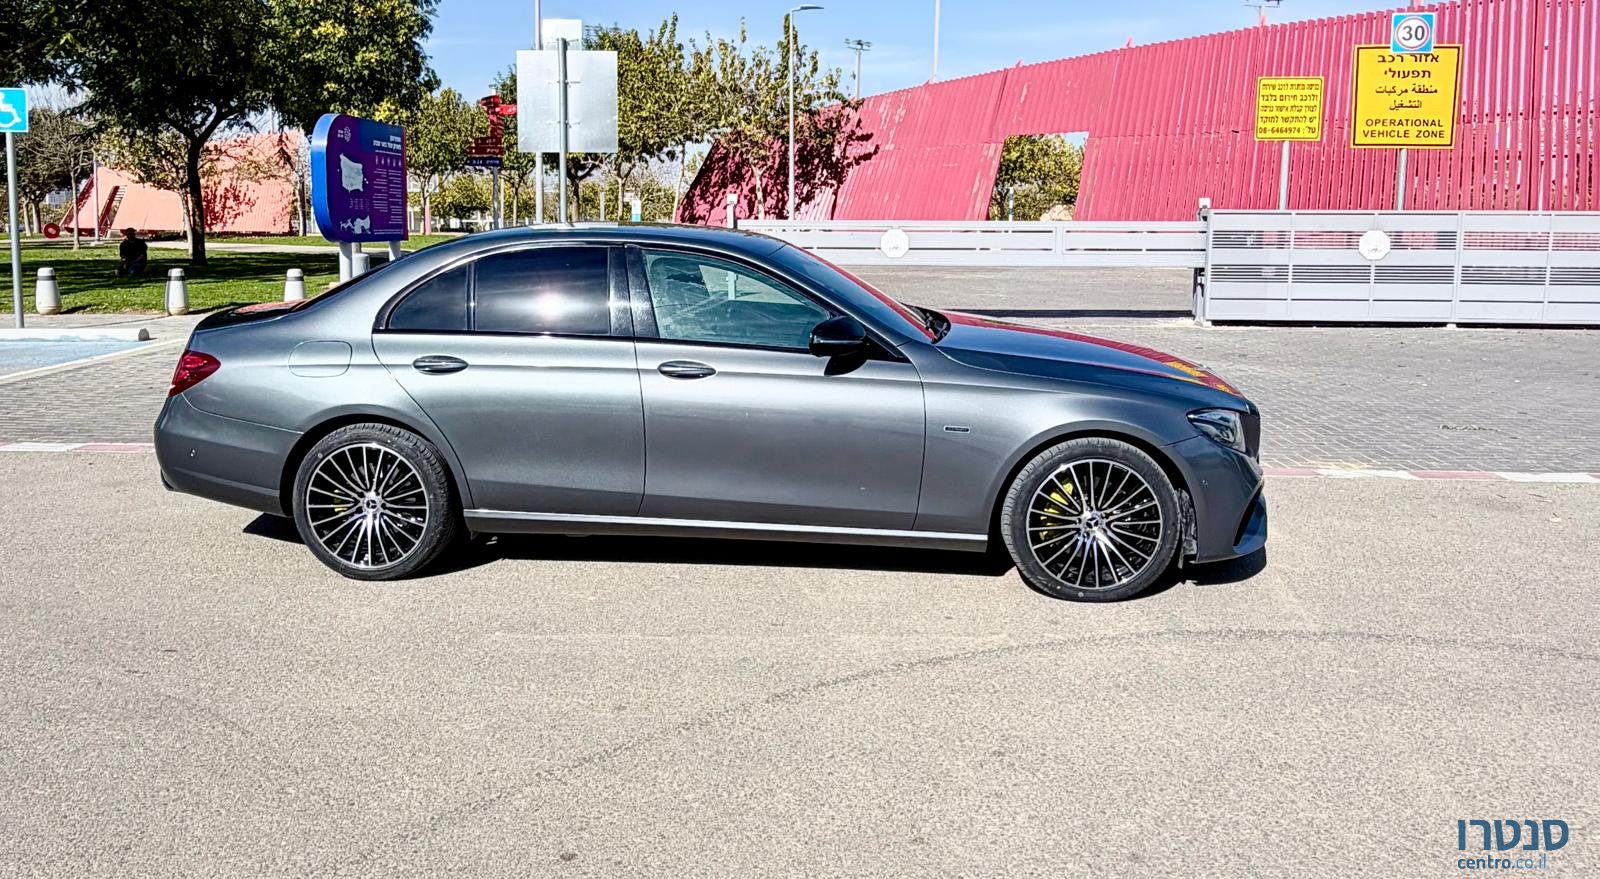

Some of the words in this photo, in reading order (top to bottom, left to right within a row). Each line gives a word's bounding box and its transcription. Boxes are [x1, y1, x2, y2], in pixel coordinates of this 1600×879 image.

[1402, 25, 1425, 41] 30
[1377, 54, 1404, 63] רכב
[1410, 54, 1439, 63] אזור
[1384, 68, 1431, 79] תפעולי
[1375, 85, 1408, 96] مركبات
[1411, 83, 1438, 94] منطقة
[1261, 93, 1277, 102] בלבד
[1279, 94, 1298, 102] חירום
[1299, 93, 1318, 102] ולרכב
[1389, 99, 1422, 111] التشغيل
[1260, 115, 1279, 124] למוקד
[1280, 115, 1307, 124] להתקשר
[1365, 118, 1443, 127] OPERATIONAL
[1258, 126, 1301, 134] 08-6464974
[1362, 129, 1410, 138] VEHICLE
[1415, 129, 1445, 139] ZONE
